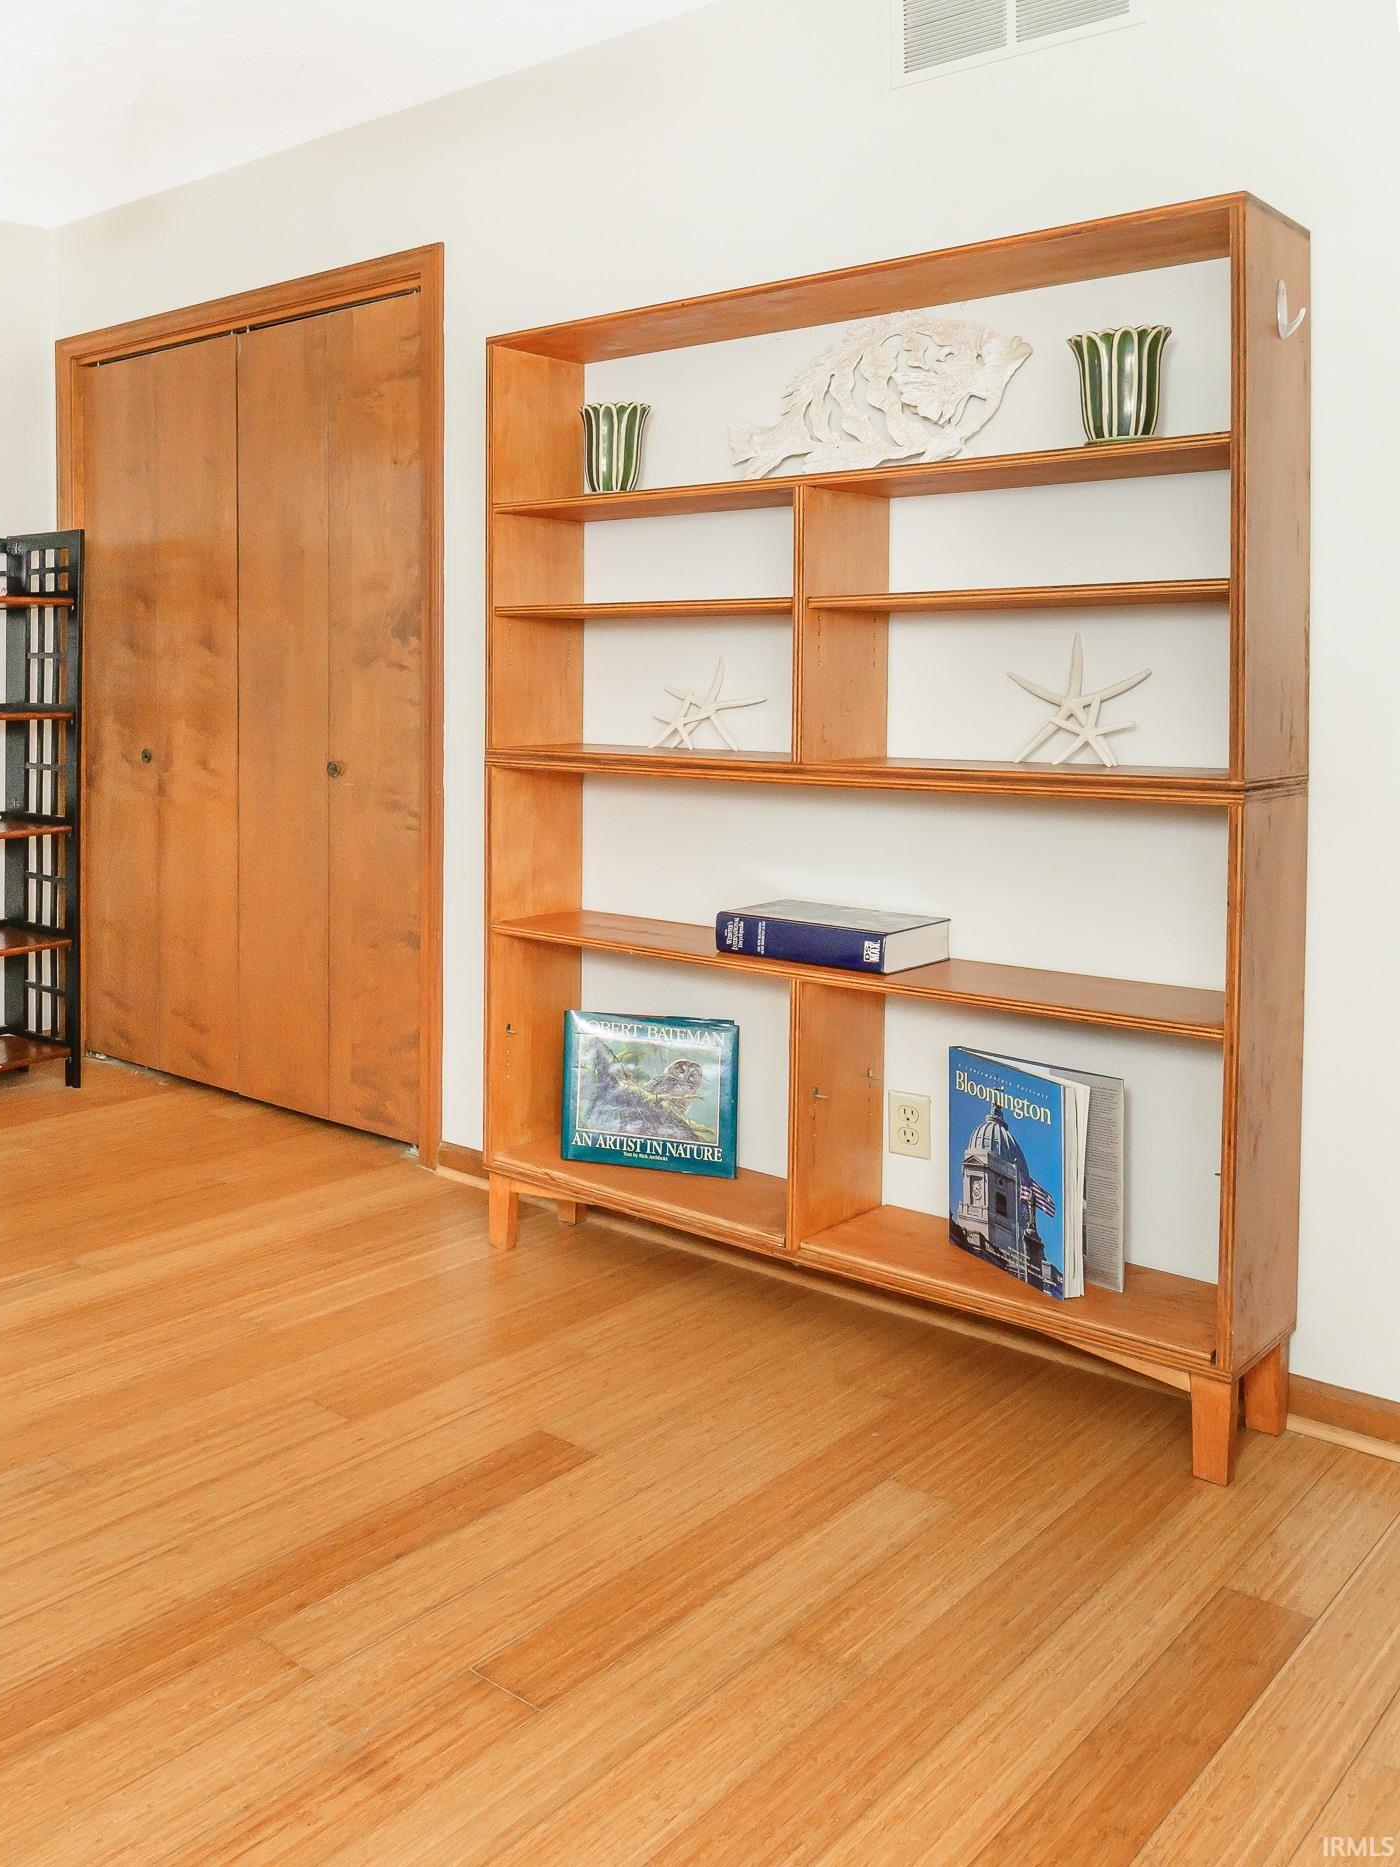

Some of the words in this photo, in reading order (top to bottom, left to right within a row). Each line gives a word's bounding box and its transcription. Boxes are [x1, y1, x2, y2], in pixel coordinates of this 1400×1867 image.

[578, 1019, 641, 1037] OBERT
[647, 1025, 726, 1044] BATEMAN
[955, 1070, 1052, 1125] Bloomington
[571, 1131, 594, 1148] AN
[596, 1134, 644, 1153] ARTIST
[646, 1139, 664, 1155] IN
[666, 1142, 723, 1162] NATURE
